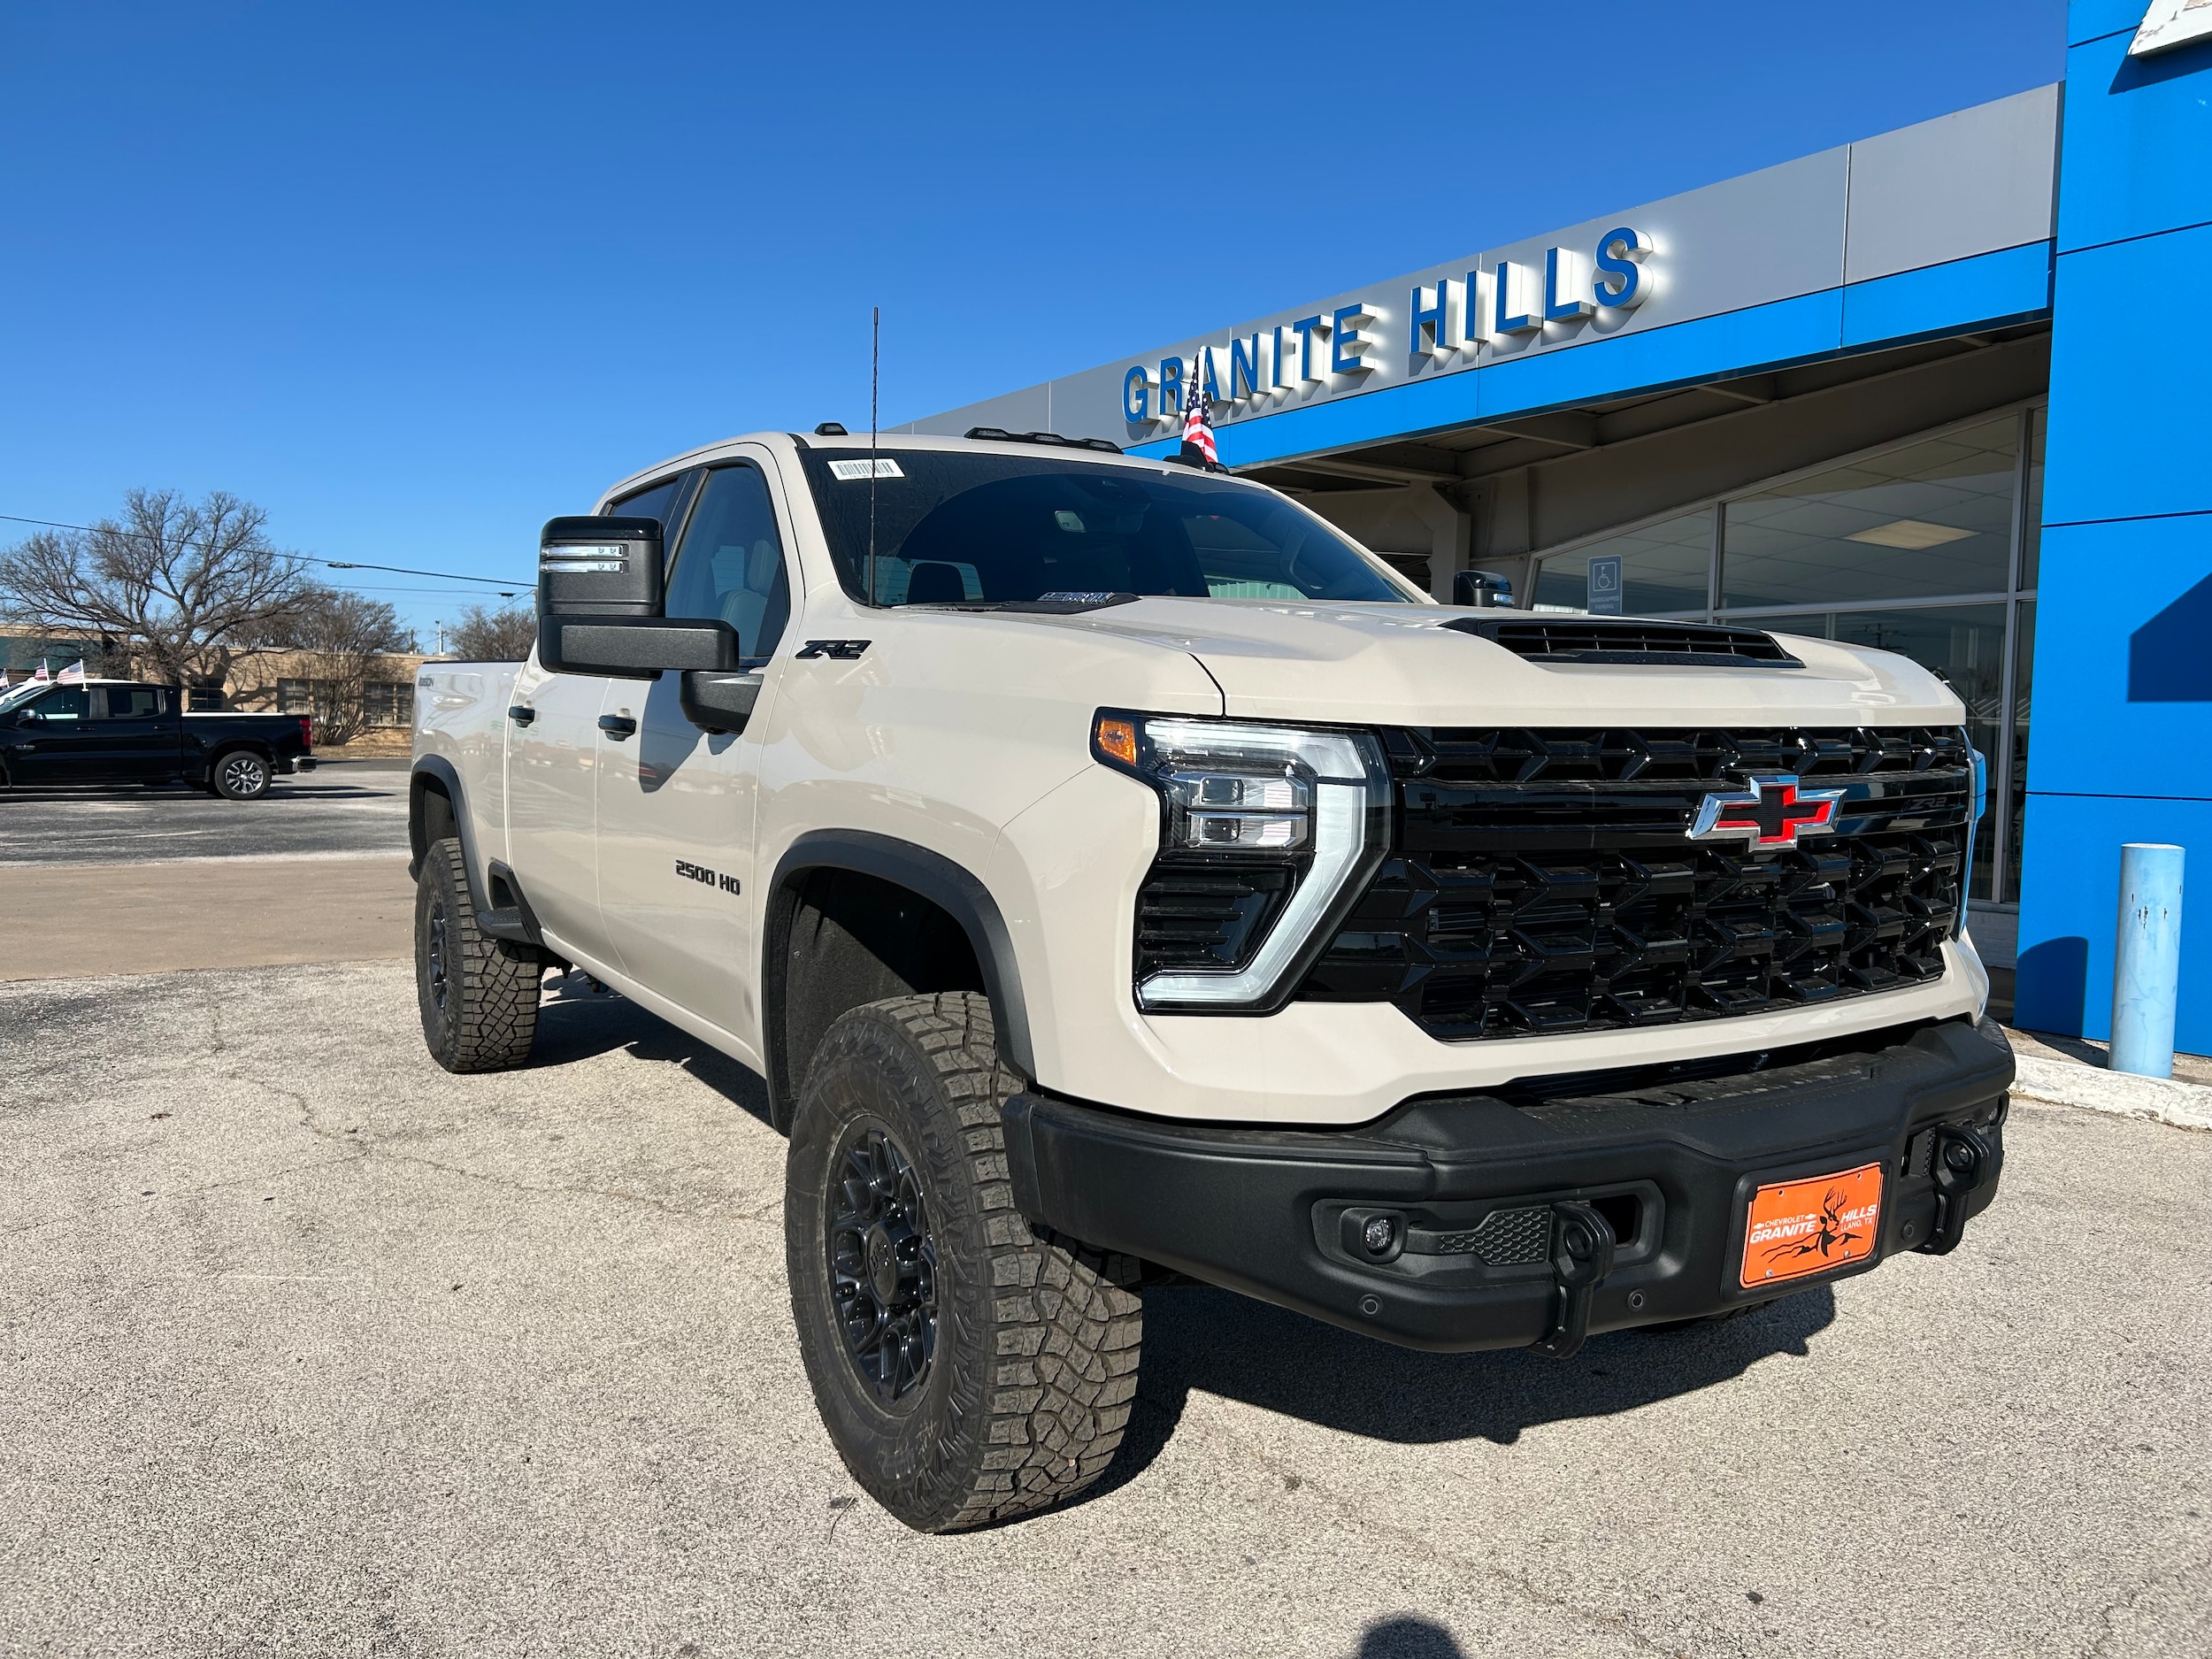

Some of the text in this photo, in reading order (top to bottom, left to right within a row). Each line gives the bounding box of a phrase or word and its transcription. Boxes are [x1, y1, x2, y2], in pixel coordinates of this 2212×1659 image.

[1123, 227, 1653, 425] GRANITE HILLS
[795, 640, 872, 659] ZR2
[676, 859, 741, 895] 2500 HD
[1749, 1203, 1878, 1244] GRANITE HILLS
[1764, 1214, 1805, 1227] CHEVROLET
[1840, 1221, 1863, 1232] LLANO,
